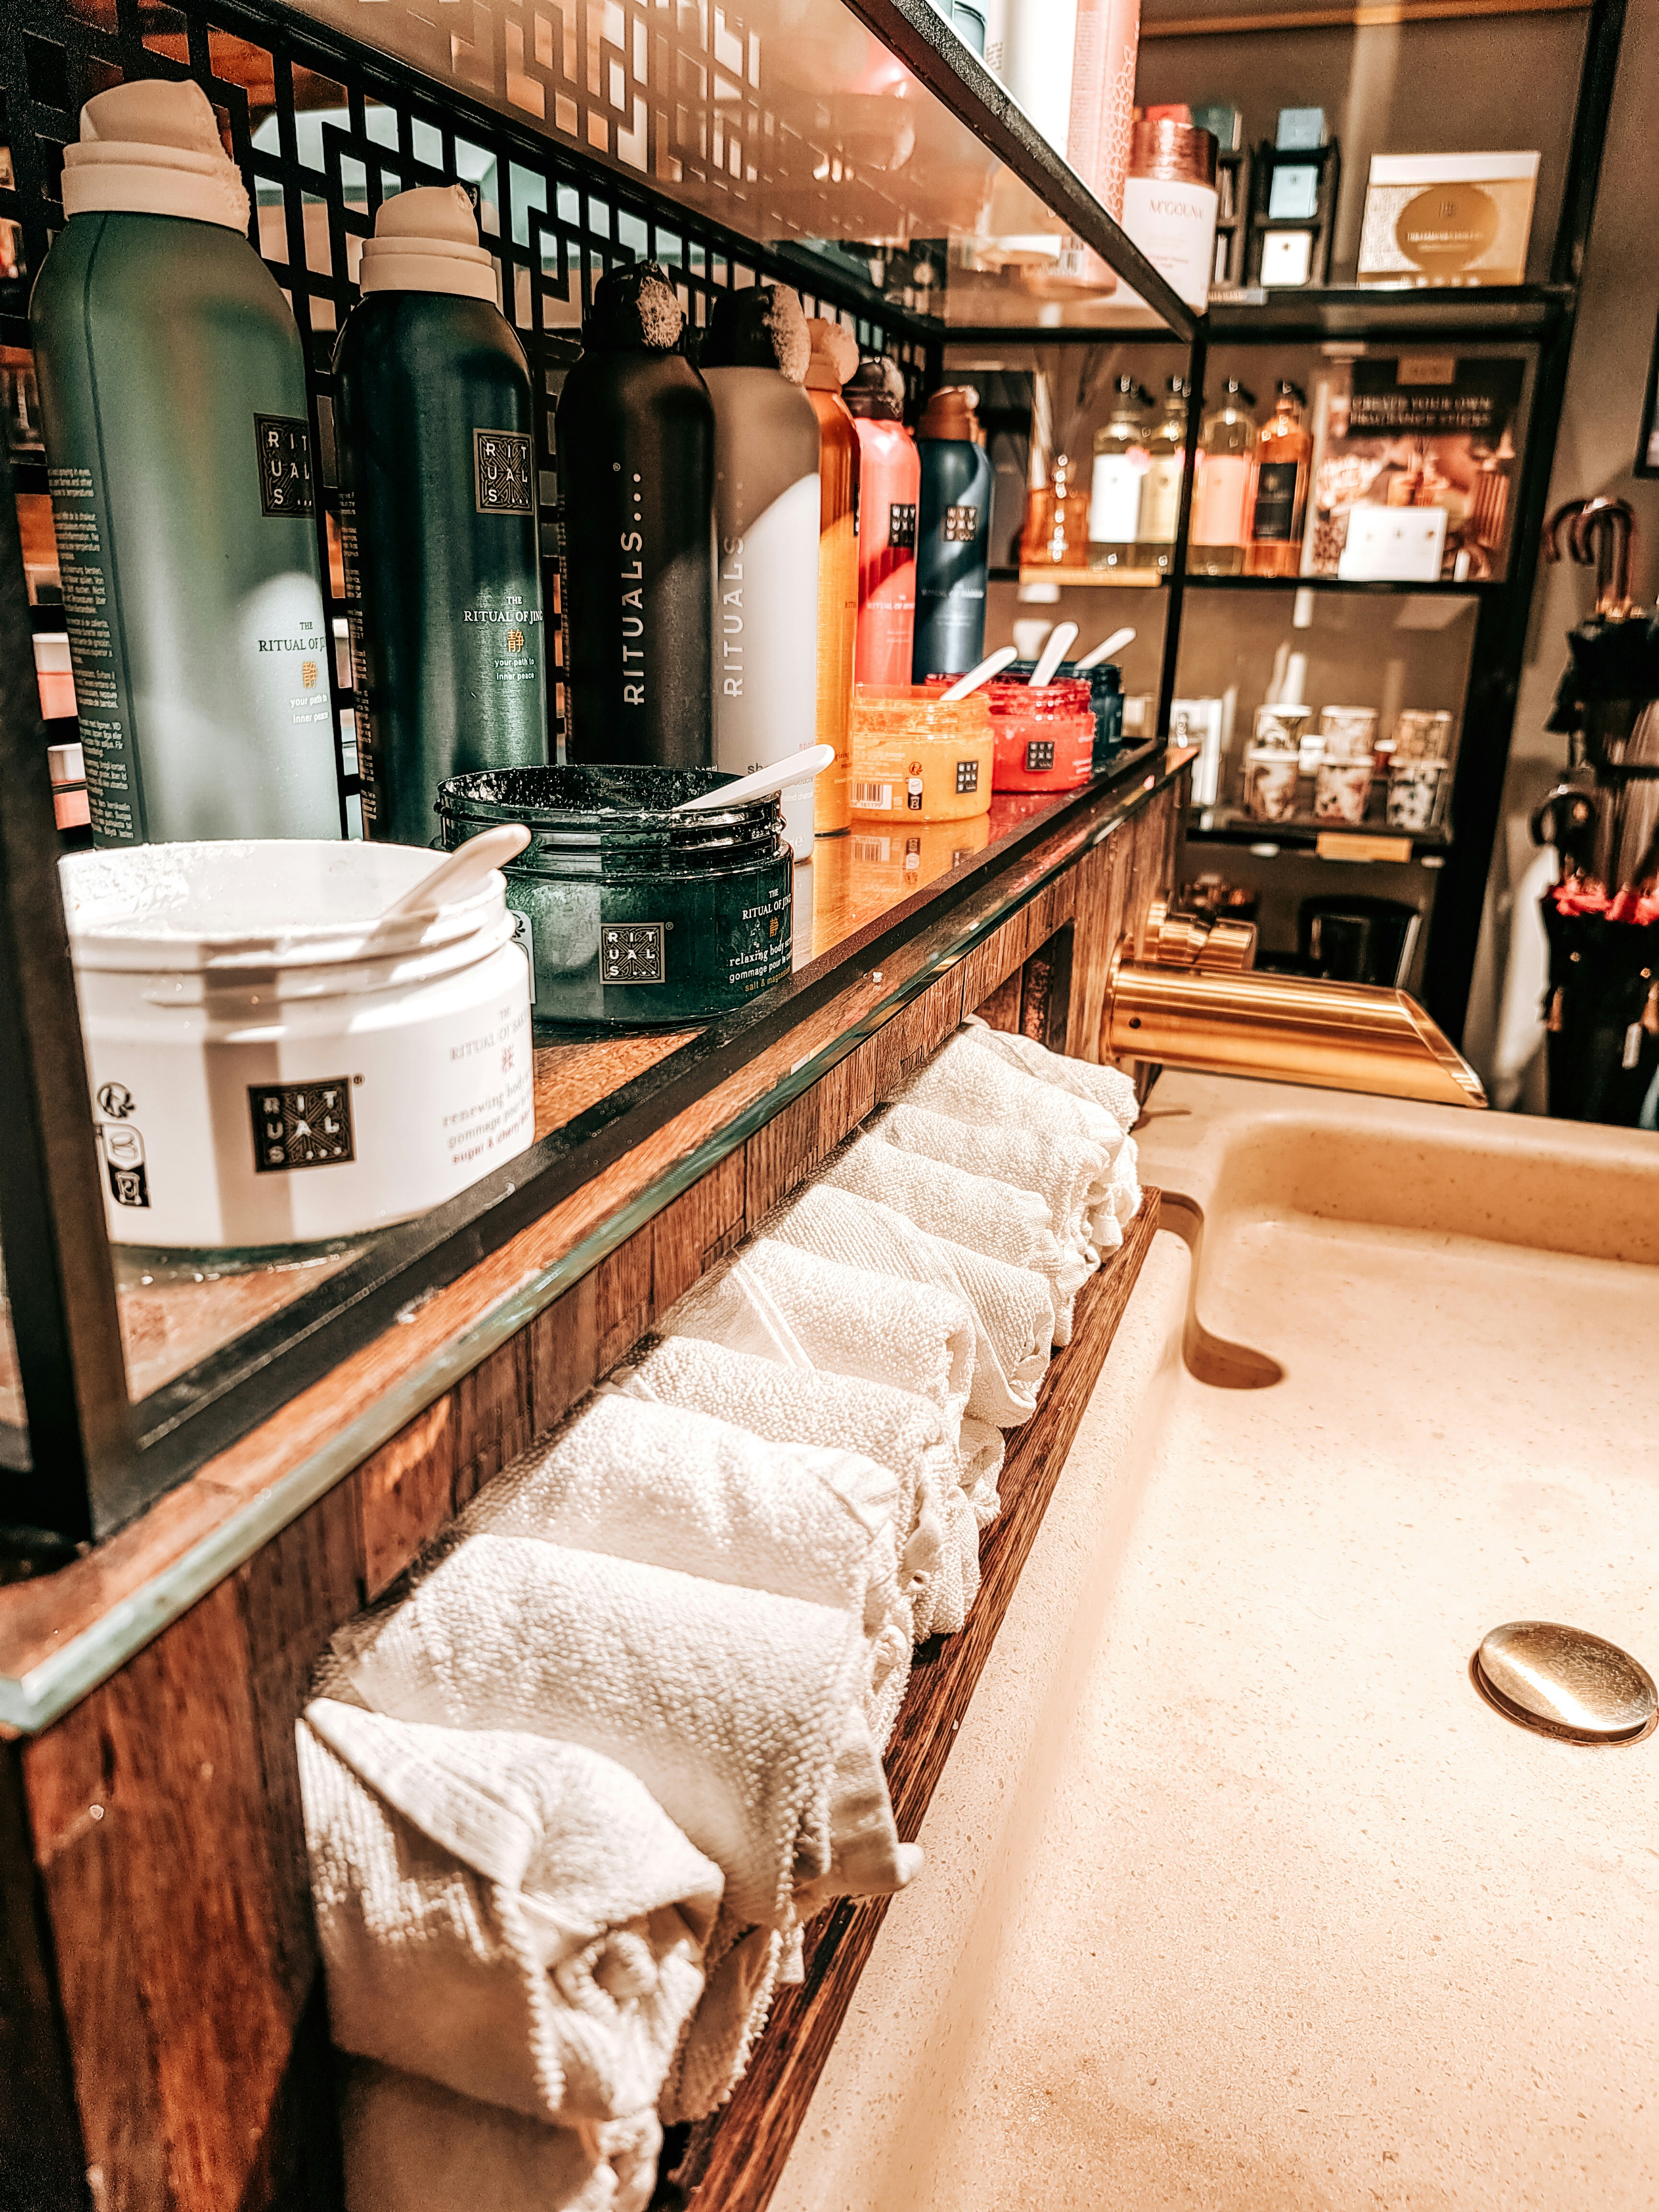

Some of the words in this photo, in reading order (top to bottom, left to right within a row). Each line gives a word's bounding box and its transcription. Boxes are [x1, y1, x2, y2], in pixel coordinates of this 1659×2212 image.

[506, 597, 522, 605] THE
[464, 610, 513, 622] RITUAL
[515, 610, 528, 622] OF
[529, 610, 543, 625] JING
[299, 621, 313, 630] THE
[258, 638, 306, 652] RITUAL
[309, 638, 319, 650] OF
[494, 660, 512, 668] your
[513, 658, 528, 667] path
[529, 657, 534, 665] to
[497, 672, 515, 680] inner
[517, 672, 534, 681] peace
[289, 697, 308, 709] your
[309, 695, 322, 706] path
[292, 714, 312, 724] inner
[769, 888, 779, 898] THE
[742, 904, 773, 920] RITUAL
[774, 899, 782, 911] OF
[781, 893, 792, 910] JING
[729, 949, 769, 967] relaxing
[770, 940, 785, 955] body
[729, 965, 767, 984] gommage
[769, 959, 781, 973] pour
[745, 980, 759, 992] salt
[761, 978, 765, 987] &
[450, 1032, 497, 1061] RITUAL
